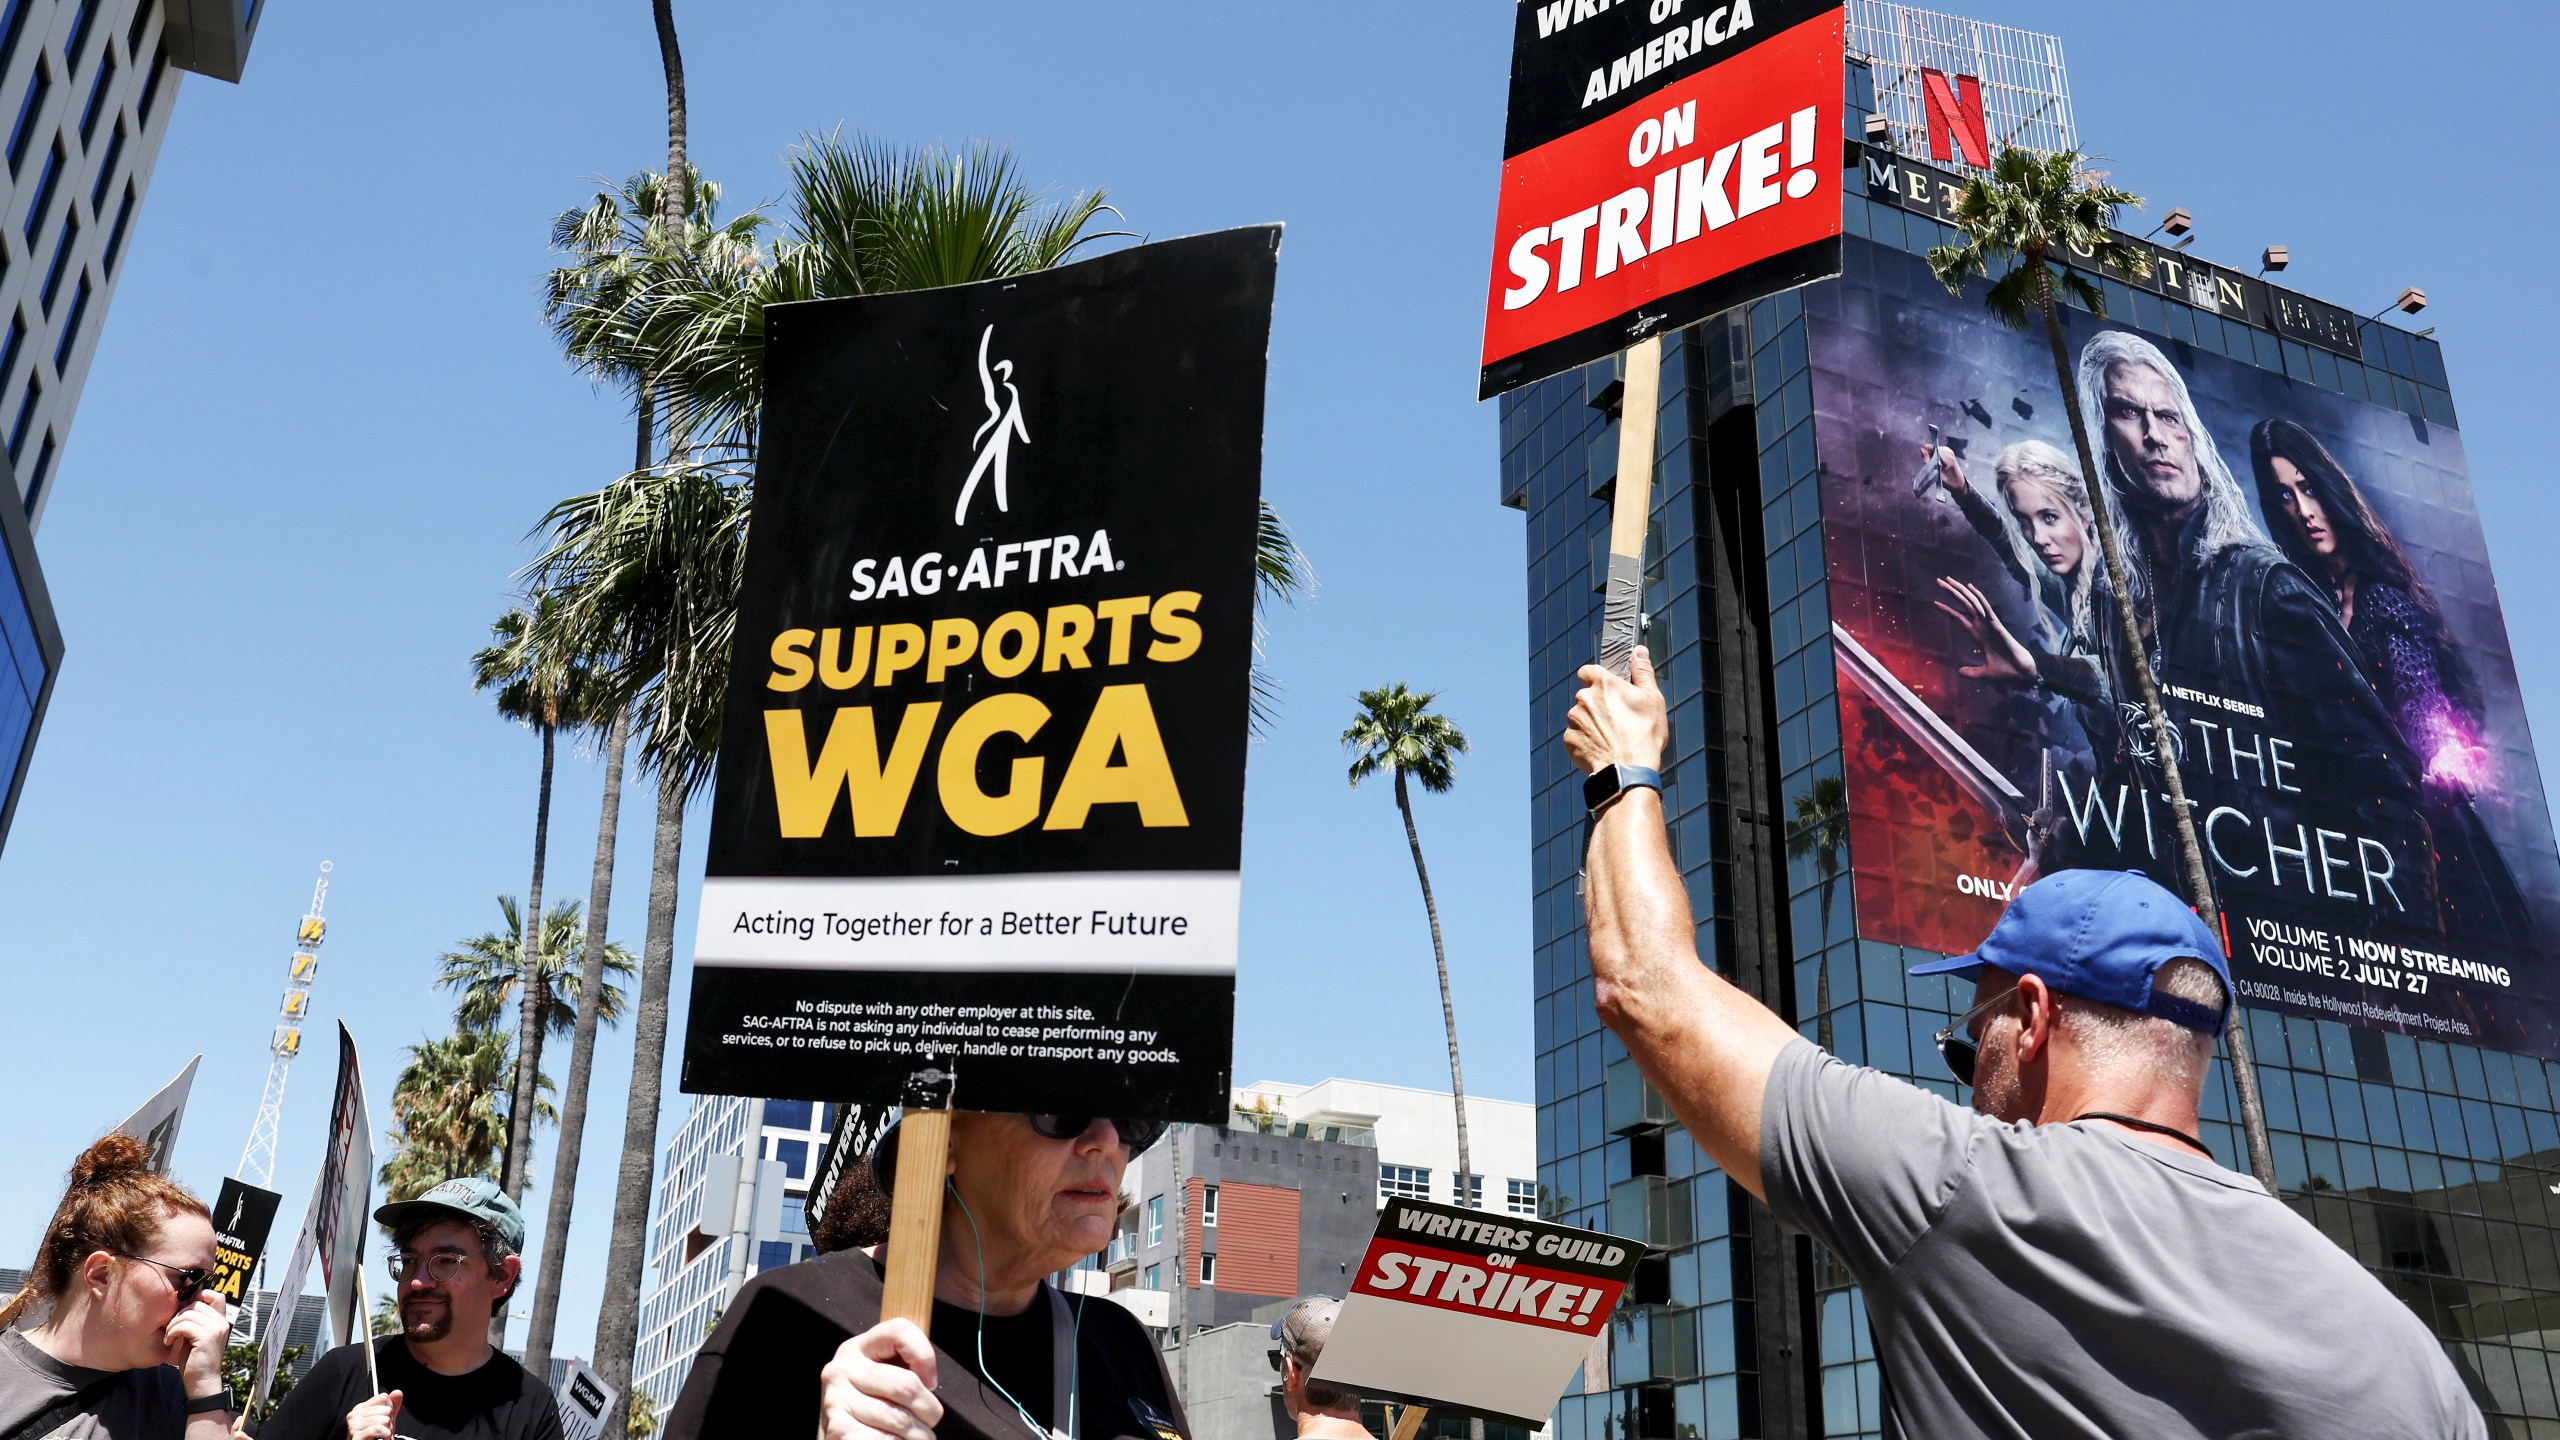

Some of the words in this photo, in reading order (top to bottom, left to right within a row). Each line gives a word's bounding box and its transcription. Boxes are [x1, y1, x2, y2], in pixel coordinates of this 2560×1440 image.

[1581, 0, 1754, 109] AMERICA
[1628, 99, 1697, 168] ON
[1921, 67, 1990, 171] N
[1503, 105, 1817, 311] STRIKE!
[766, 590, 1203, 693] SUPPORTS
[2162, 683, 2171, 696] A
[2172, 685, 2222, 708] NETFLIX
[2222, 698, 2265, 718] SERIES
[763, 683, 1191, 839] WGA
[2190, 718, 2301, 793] THE
[1956, 873, 2014, 902] ONLY
[733, 910, 815, 941] Acting
[823, 911, 933, 942] Together
[939, 911, 974, 936] for
[980, 917, 993, 936] a
[1001, 911, 1082, 936] Better
[1091, 910, 1188, 936] Future
[2246, 916, 2330, 953] VOLUME
[2334, 935, 2344, 955] 1
[2348, 937, 2396, 965] NOW
[2401, 949, 2511, 988] STREAMING
[277, 919, 323, 1052] KTLA
[2251, 942, 2335, 978] VOLUME
[2338, 960, 2351, 981] 2
[2354, 964, 2401, 990] JULY
[2405, 974, 2429, 996] 27
[742, 1015, 814, 1031] SAG-AFTRA
[816, 1018, 826, 1031] is
[829, 1020, 850, 1033] not
[853, 1020, 893, 1037] asking
[896, 1023, 918, 1037] any
[921, 1021, 983, 1037] individual
[986, 1025, 1000, 1037] to
[1002, 1026, 1040, 1039] cease
[1043, 1025, 1125, 1045] performing
[1128, 1029, 1157, 1045] any
[796, 1000, 814, 1014] No
[816, 1000, 863, 1017] dispute
[866, 1001, 893, 1016] with
[895, 1005, 918, 1019] any
[920, 1003, 955, 1017] other
[957, 1004, 1017, 1021] employer
[1019, 1006, 1033, 1019] at
[1037, 1005, 1063, 1020] this
[1066, 1005, 1095, 1021] site.
[2240, 979, 2254, 997] CA
[2254, 982, 2283, 1002] 90028.
[2283, 987, 2307, 1007] Inside
[2308, 992, 2321, 1009] the
[2362, 1001, 2422, 1028] Redevelopment
[2423, 1013, 2452, 1035] Project
[2451, 1018, 2473, 1036] Area.
[722, 1033, 774, 1048] services,
[776, 1037, 790, 1047] or
[792, 1035, 805, 1048] to
[808, 1035, 846, 1050] refuse
[849, 1037, 862, 1050] to
[865, 1037, 891, 1053] pick
[893, 1042, 912, 1054] up,
[915, 1039, 961, 1056] deliver,
[964, 1041, 1008, 1056] handle
[1010, 1045, 1025, 1056] or
[1028, 1044, 1094, 1061] transport
[1097, 1047, 1125, 1064] any
[1128, 1048, 1180, 1065] goods.
[811, 1103, 862, 1222] WRITERS
[854, 1119, 868, 1156] OF
[426, 1181, 476, 1206] AUI
[1398, 1207, 1533, 1251] WRITERS
[1535, 1234, 1626, 1267] GUILD
[1486, 1252, 1517, 1269] ON
[213, 1263, 241, 1299] GA
[1369, 1252, 1604, 1327] STRIKE!
[574, 1380, 603, 1410] WGAW
